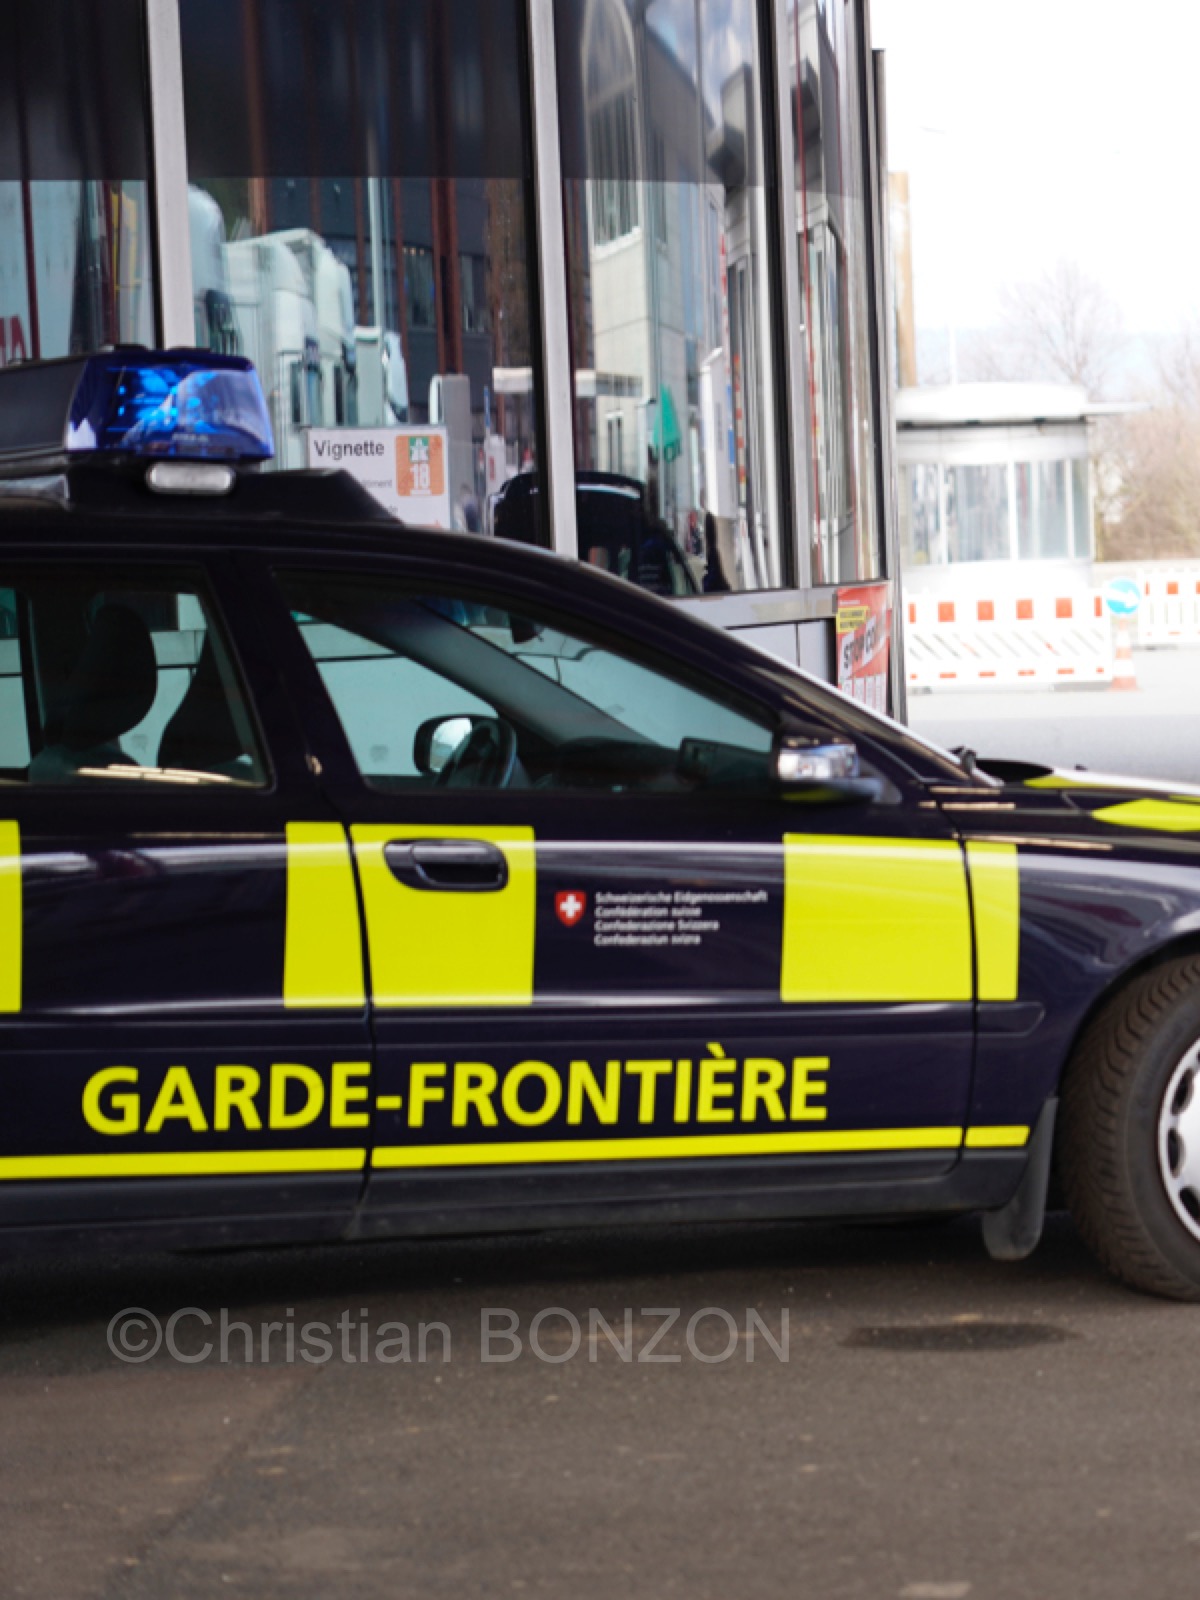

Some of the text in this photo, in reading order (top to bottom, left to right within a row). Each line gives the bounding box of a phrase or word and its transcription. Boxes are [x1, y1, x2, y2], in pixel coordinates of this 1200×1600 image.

[313, 439, 385, 461] Vignette
[409, 463, 431, 490] 18
[82, 1042, 830, 1135] GARDE-FRONTIÈRE
